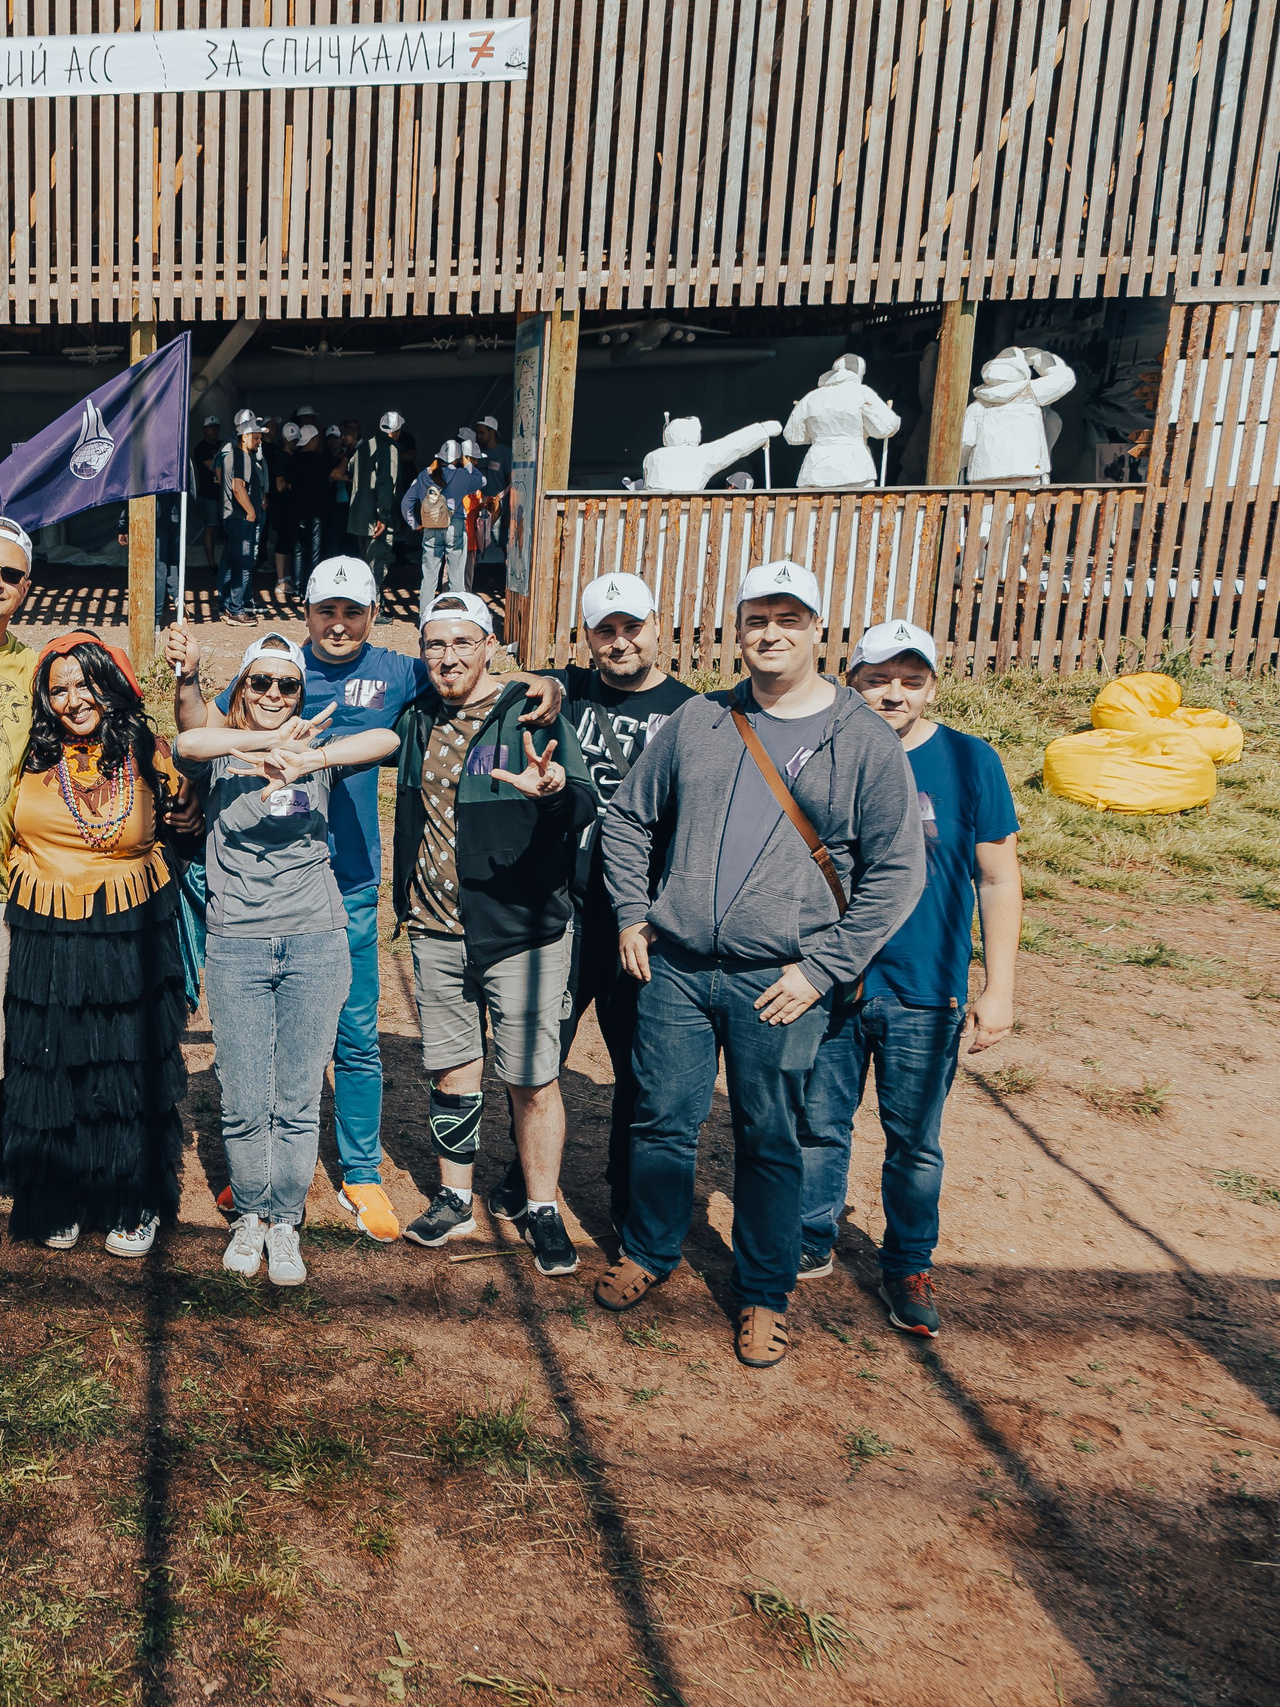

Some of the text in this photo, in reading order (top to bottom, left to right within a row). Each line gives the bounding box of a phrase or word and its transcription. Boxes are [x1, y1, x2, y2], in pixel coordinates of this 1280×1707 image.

[63, 44, 117, 85] АСС
[204, 30, 496, 81] ЗА СПИЧКАМИ 7
